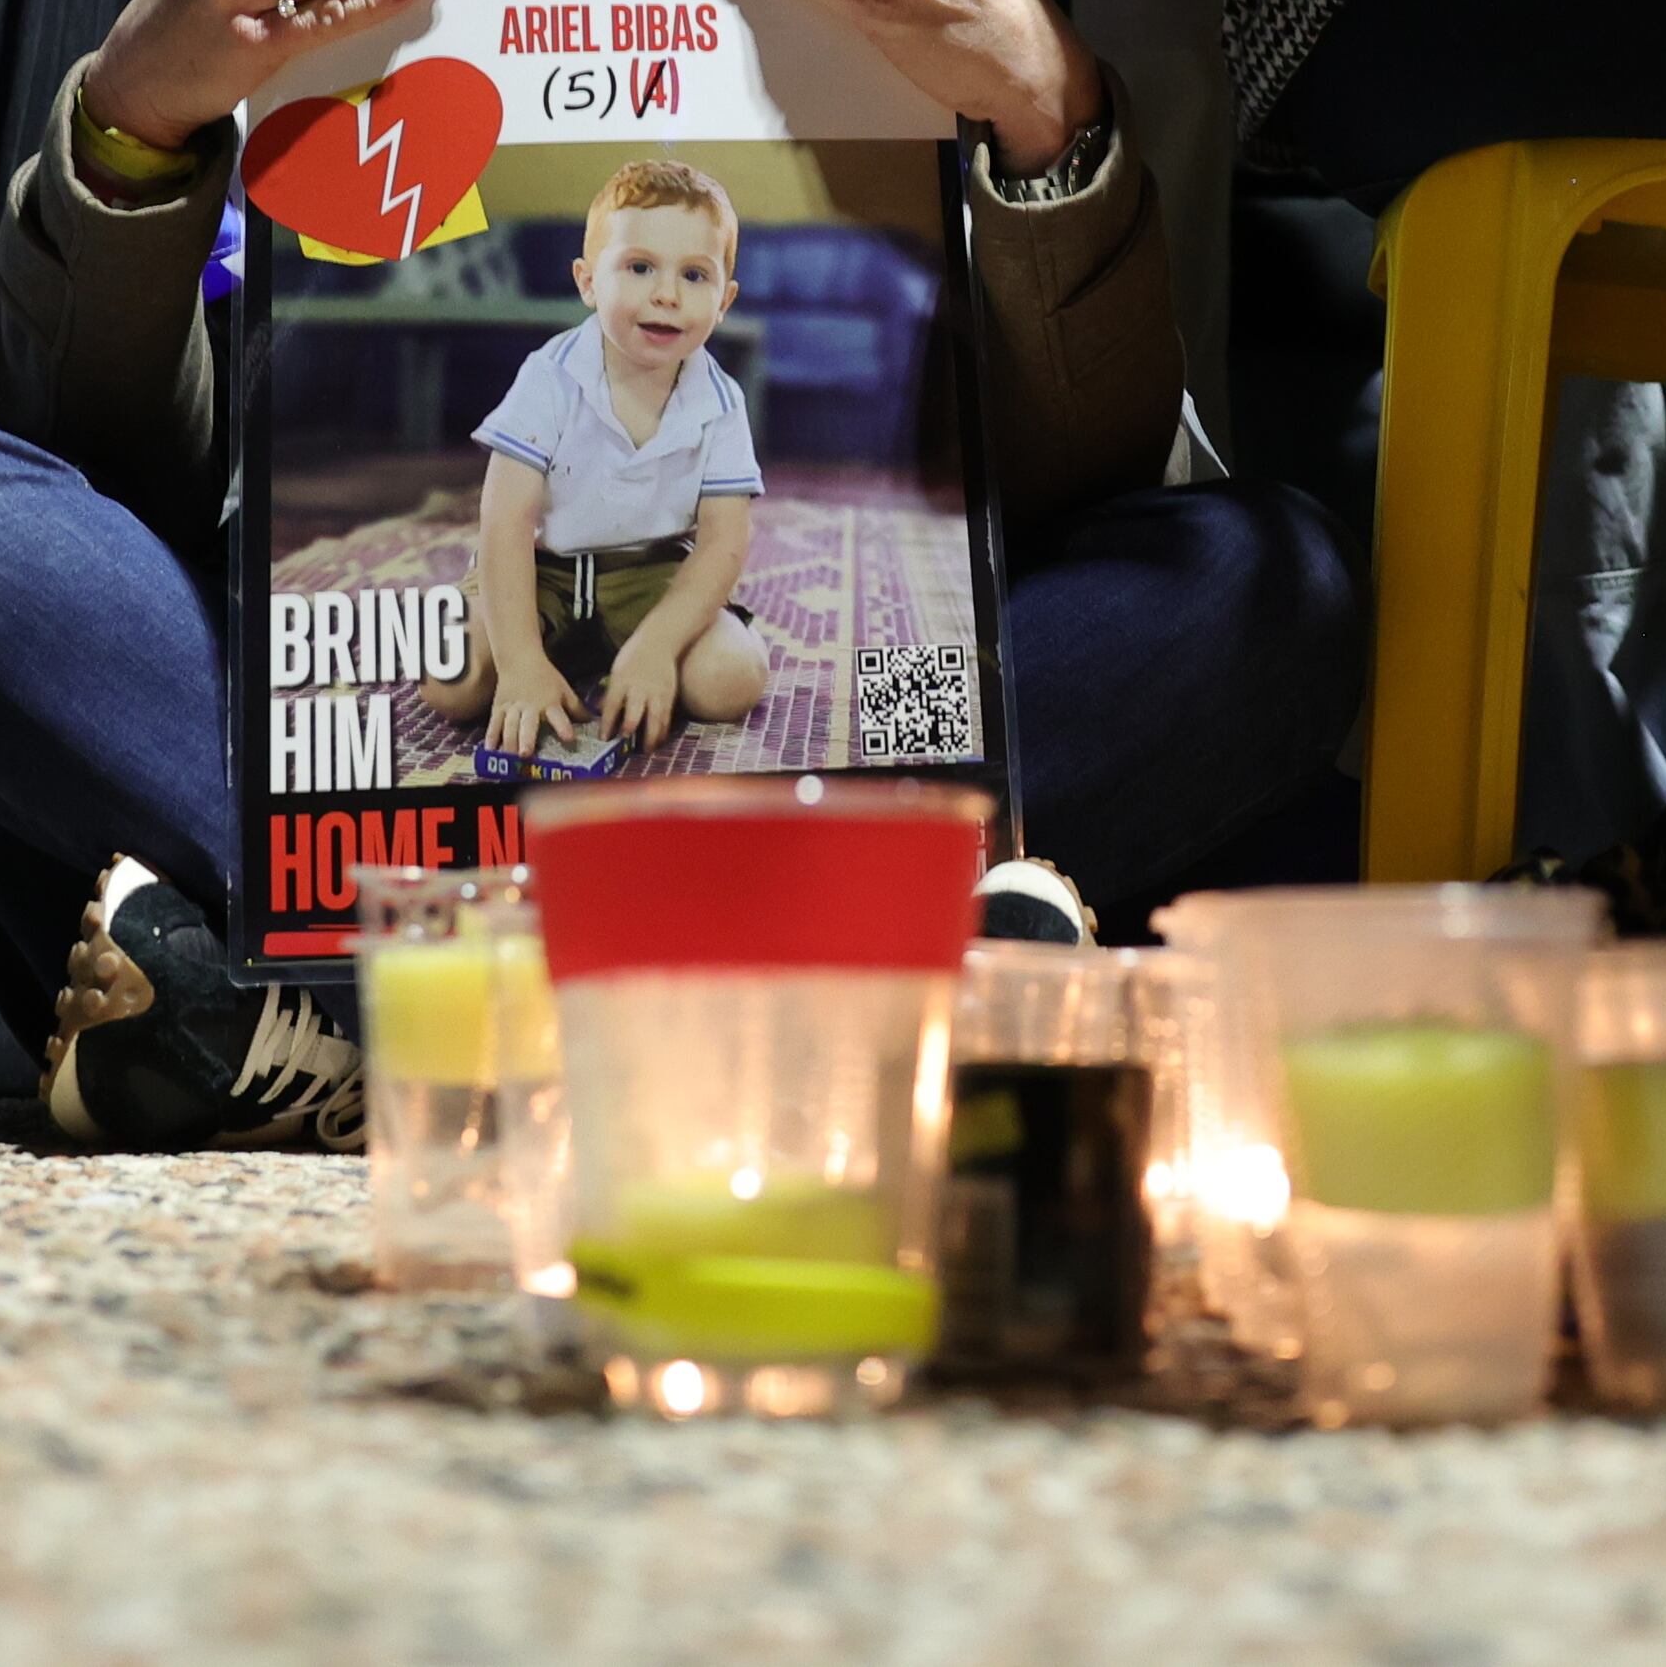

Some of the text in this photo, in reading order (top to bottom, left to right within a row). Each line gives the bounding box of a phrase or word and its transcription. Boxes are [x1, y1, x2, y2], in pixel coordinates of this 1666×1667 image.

[499, 3, 718, 55] ARIEL BIBAS
[543, 66, 617, 120] (5)
[270, 584, 466, 688] BRING
[270, 694, 392, 795] HIM
[270, 806, 455, 913] HOME
